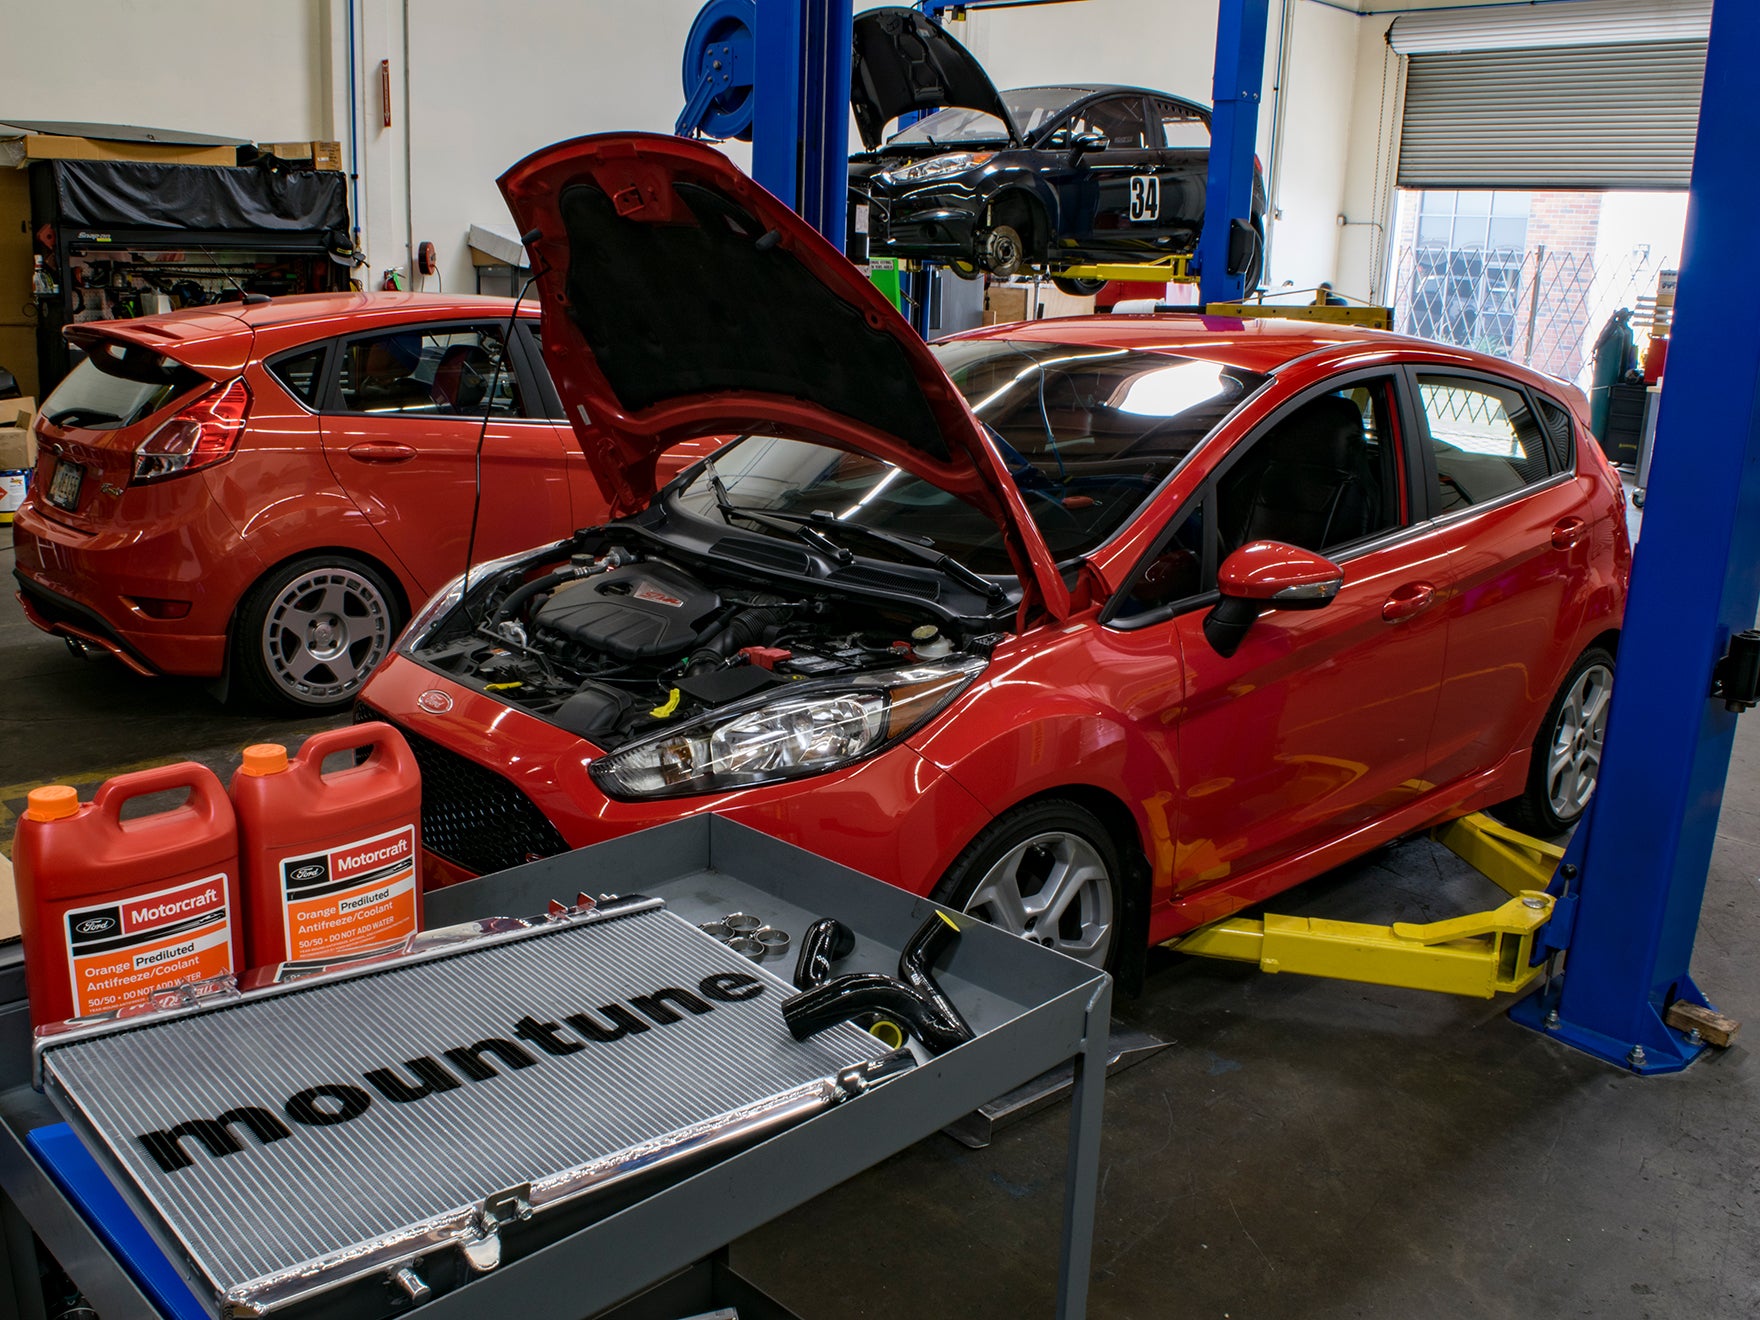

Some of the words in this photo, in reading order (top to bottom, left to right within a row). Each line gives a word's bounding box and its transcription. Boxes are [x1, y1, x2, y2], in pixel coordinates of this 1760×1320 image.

[1132, 177, 1158, 219] 34
[338, 839, 408, 872] Motorcraft
[131, 889, 217, 925] Motorcraft
[297, 907, 336, 921] Orange
[340, 889, 389, 911] Prediluted
[298, 902, 393, 934] Antifreeze/Coolant
[299, 937, 323, 949] 50/50
[329, 931, 340, 942] DO
[341, 929, 356, 939] NOT
[357, 925, 372, 935] ADD
[372, 916, 395, 929] WATER
[85, 961, 130, 978] Orange
[135, 943, 195, 967] Prediluted
[87, 956, 200, 992] Antifreeze/Coolant
[88, 995, 116, 1008] 50/50
[123, 988, 136, 1000] DO
[137, 985, 154, 998] NOT
[156, 980, 173, 991] ADD
[174, 971, 202, 986] WTER
[135, 971, 766, 1174] mountune
